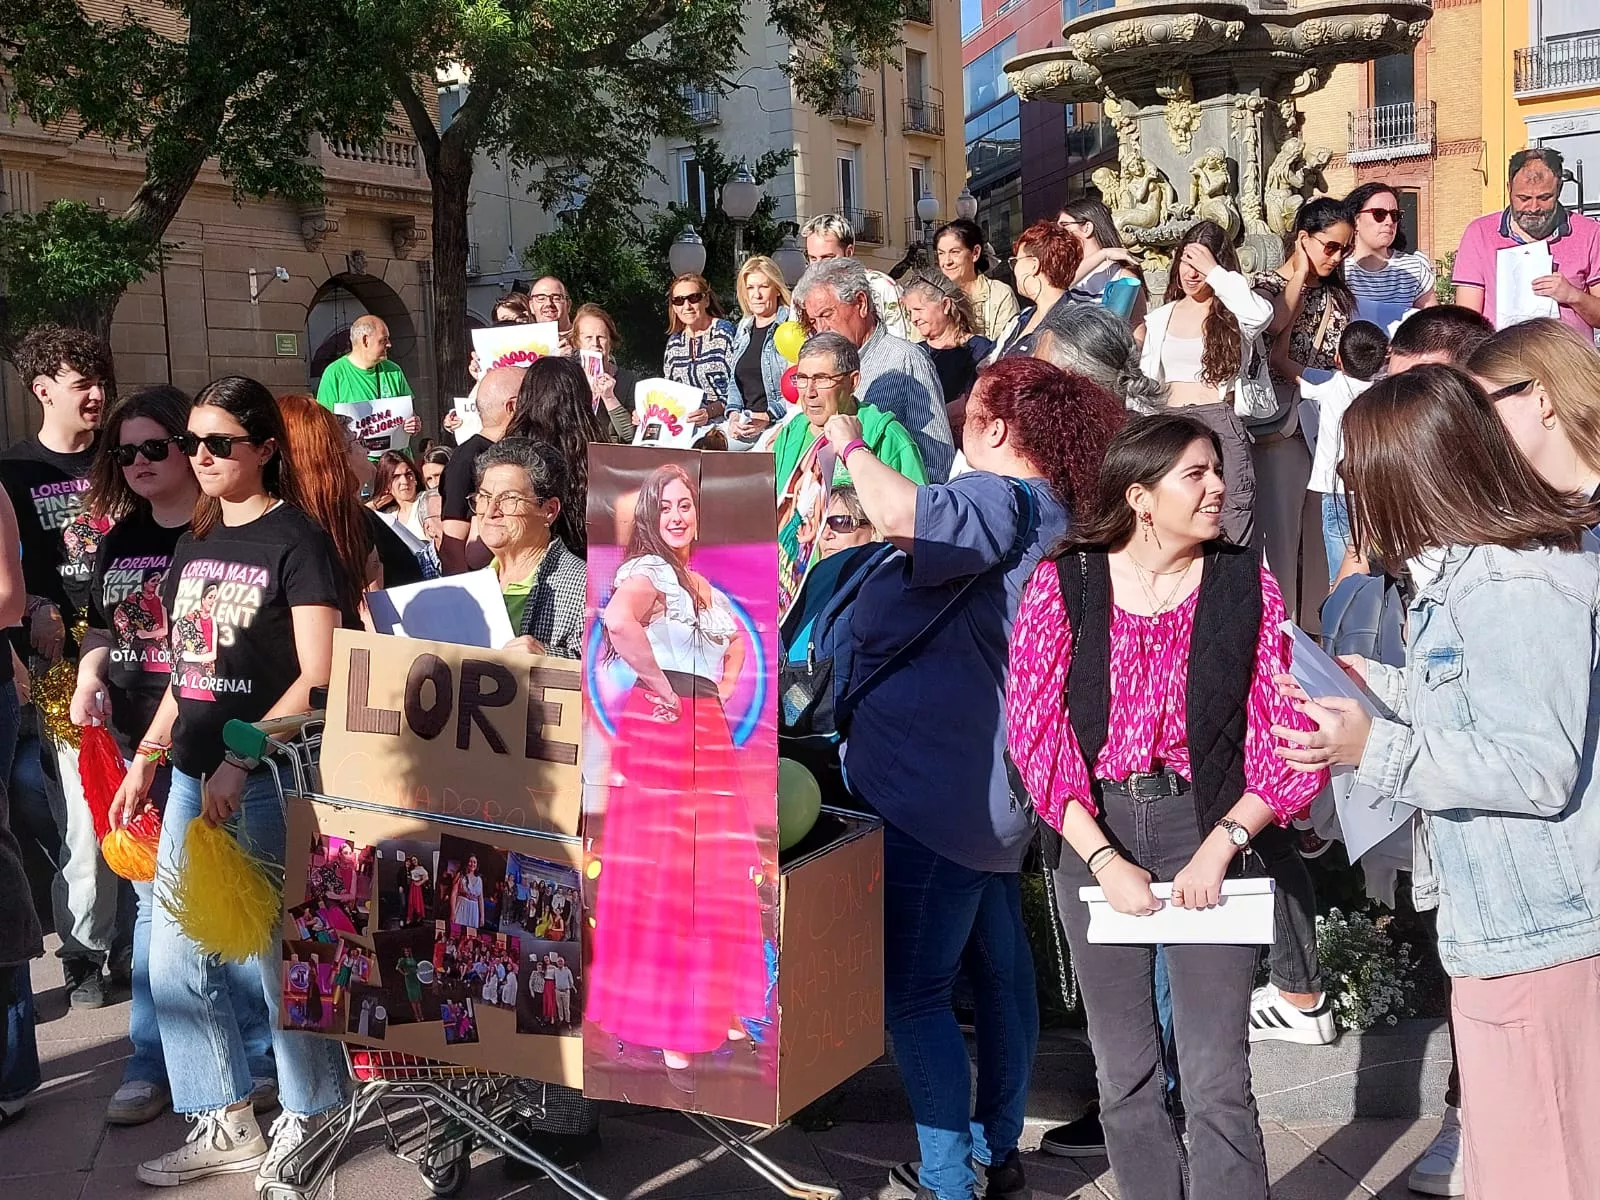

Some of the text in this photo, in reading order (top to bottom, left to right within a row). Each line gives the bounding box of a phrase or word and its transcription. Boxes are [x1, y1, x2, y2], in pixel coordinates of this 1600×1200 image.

[355, 409, 392, 429] LORENA
[30, 479, 93, 498] LORENA
[109, 555, 167, 569] LORENA
[181, 560, 223, 580] LORENA
[224, 563, 268, 588] MATA
[190, 675, 253, 694] LORENA!
[346, 647, 581, 766] LORE
